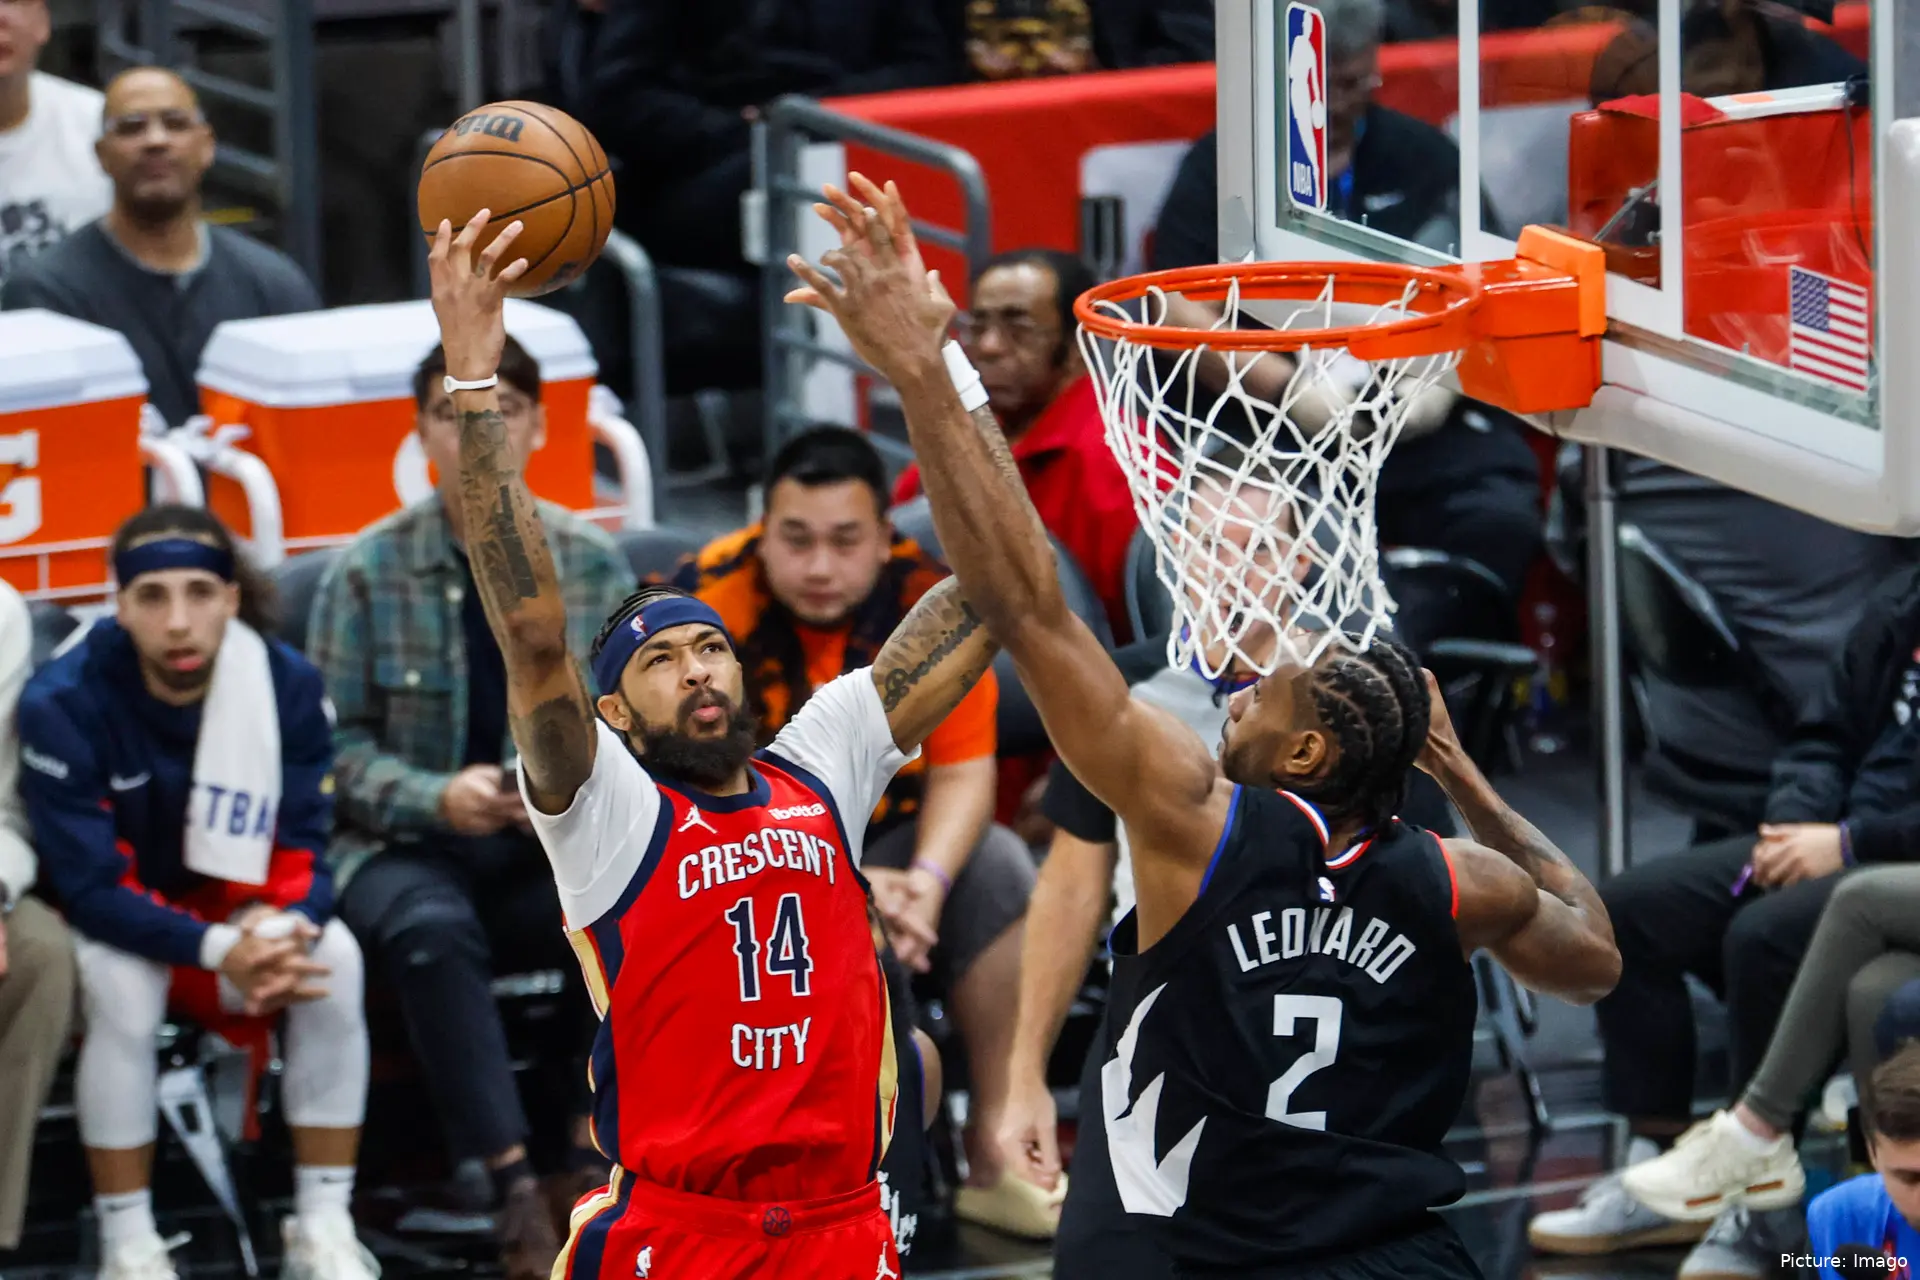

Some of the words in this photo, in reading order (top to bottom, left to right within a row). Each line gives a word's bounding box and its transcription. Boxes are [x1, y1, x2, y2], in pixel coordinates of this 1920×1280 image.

[1293, 161, 1313, 197] NBA
[768, 803, 826, 821] ibotta
[677, 827, 837, 900] CRESCENT
[724, 892, 815, 1003] 14
[1226, 905, 1417, 985] LEONARD
[731, 1016, 812, 1071] CITY
[1265, 994, 1343, 1132] 2
